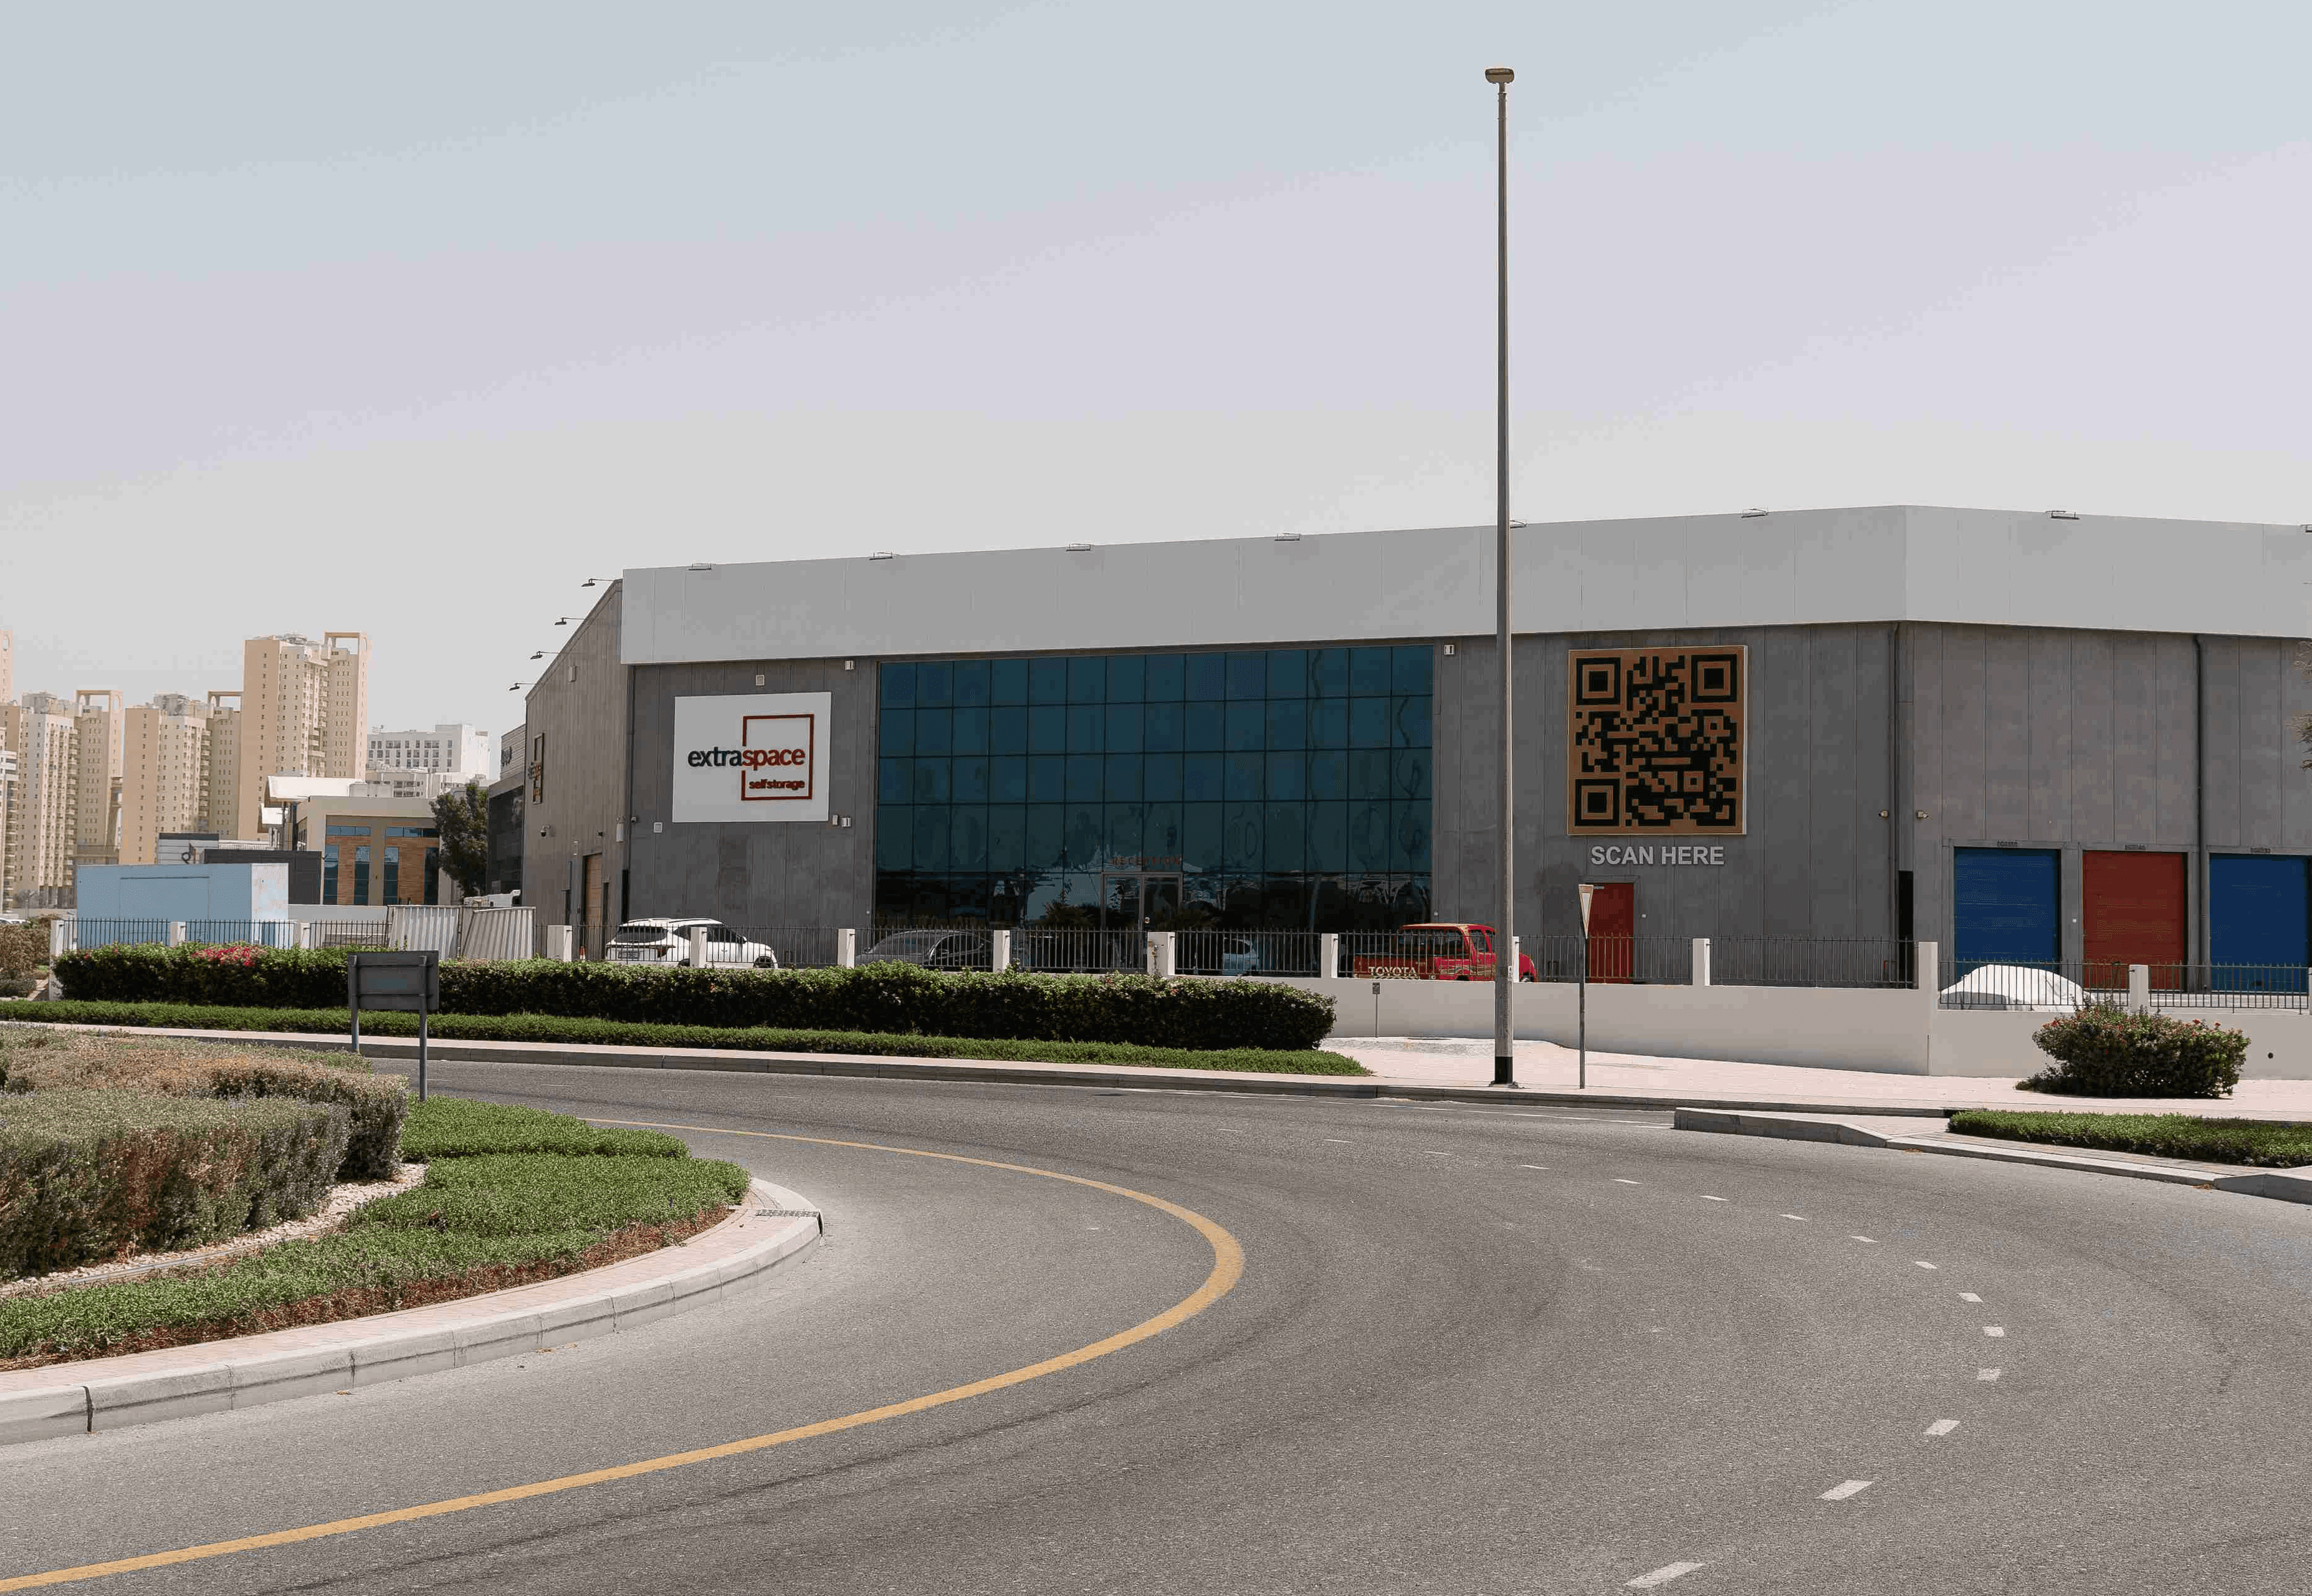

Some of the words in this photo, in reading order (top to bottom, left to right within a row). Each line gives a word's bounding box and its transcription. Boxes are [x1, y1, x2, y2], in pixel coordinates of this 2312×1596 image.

[687, 747, 806, 771] extraspace
[1591, 846, 1654, 865] SCAN
[1661, 846, 1724, 865] HERE
[1368, 966, 1418, 977] TOYOTA
